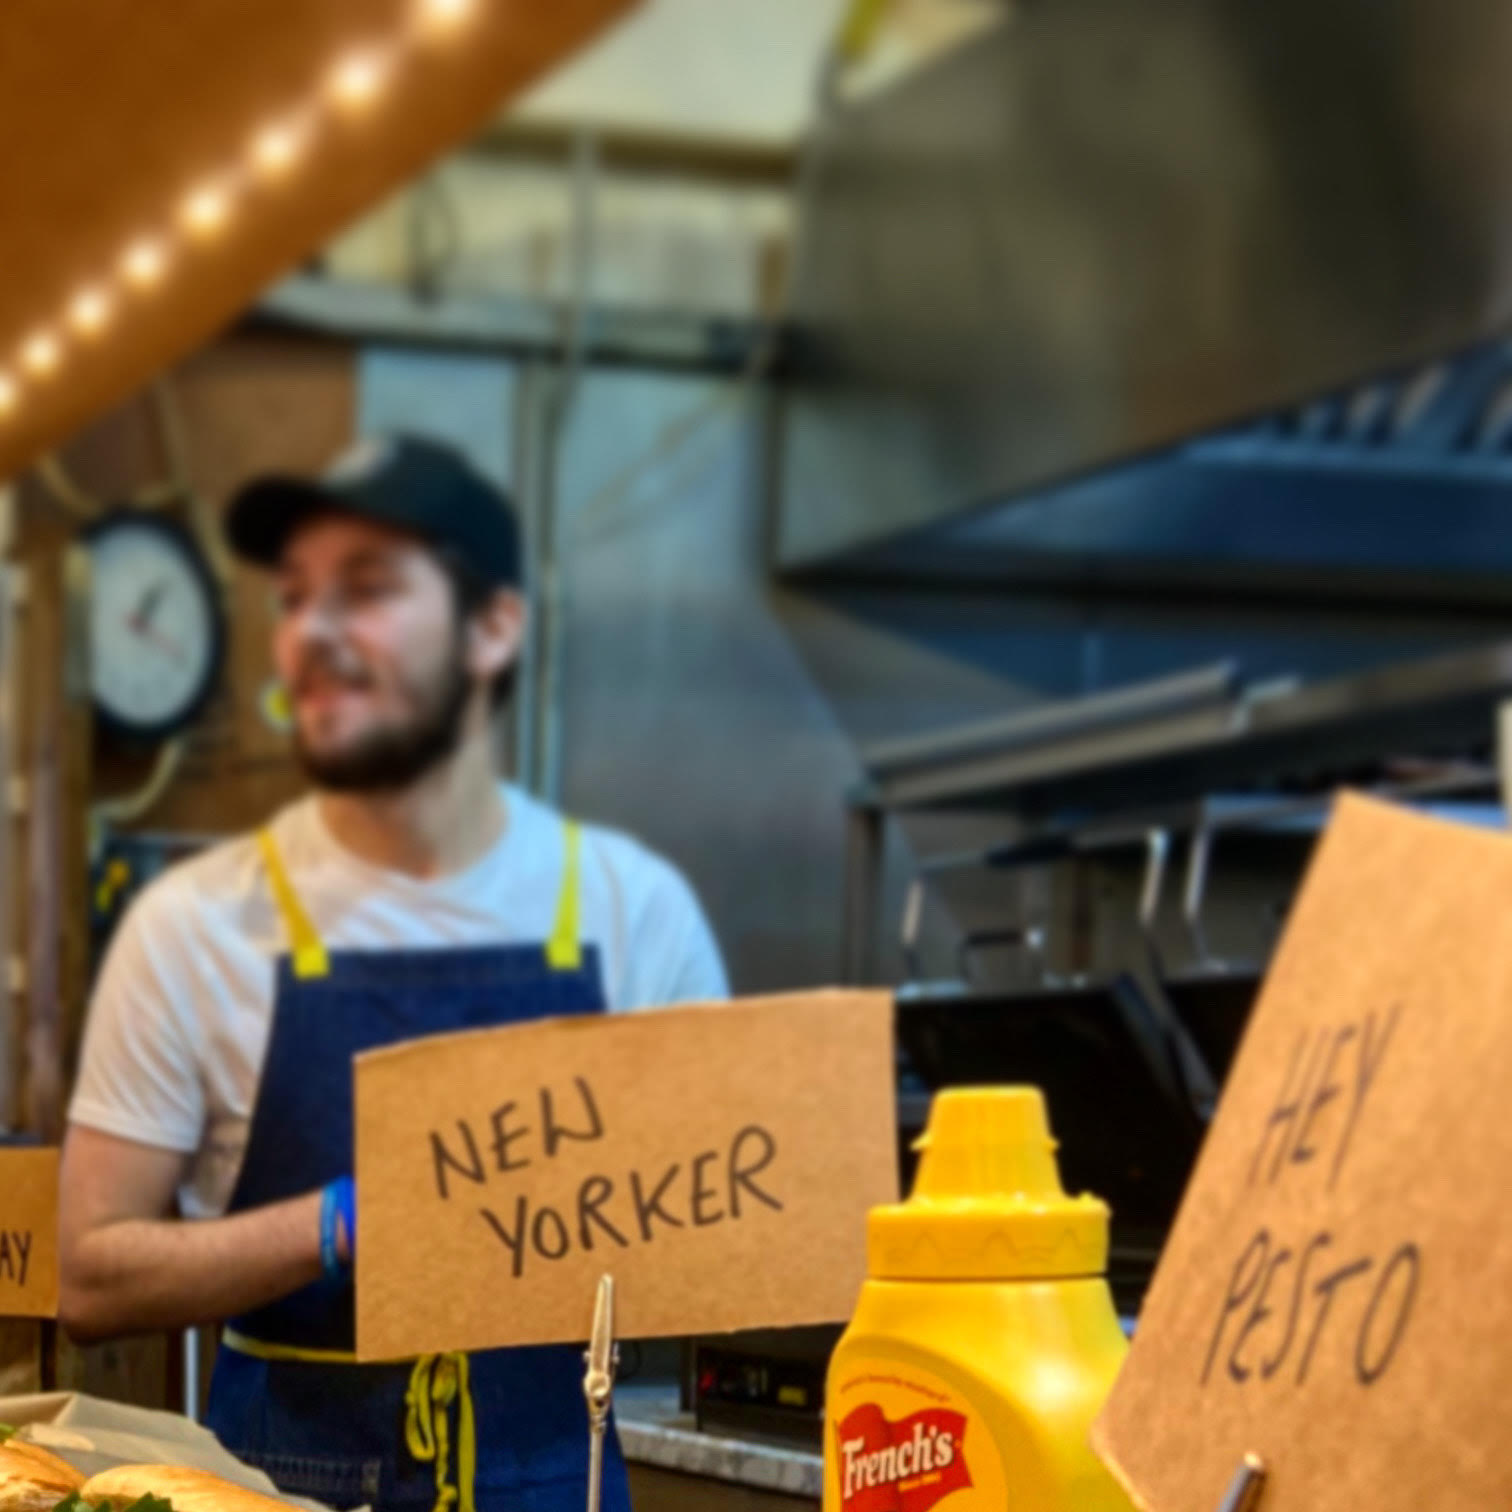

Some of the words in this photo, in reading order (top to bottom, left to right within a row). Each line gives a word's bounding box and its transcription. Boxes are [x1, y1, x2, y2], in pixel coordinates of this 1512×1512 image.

[430, 1076, 603, 1199] NEW
[1245, 1004, 1399, 1189] HEY
[482, 1125, 783, 1278] YORKER
[1200, 1228, 1421, 1387] PESTO
[843, 1421, 953, 1499] French's
